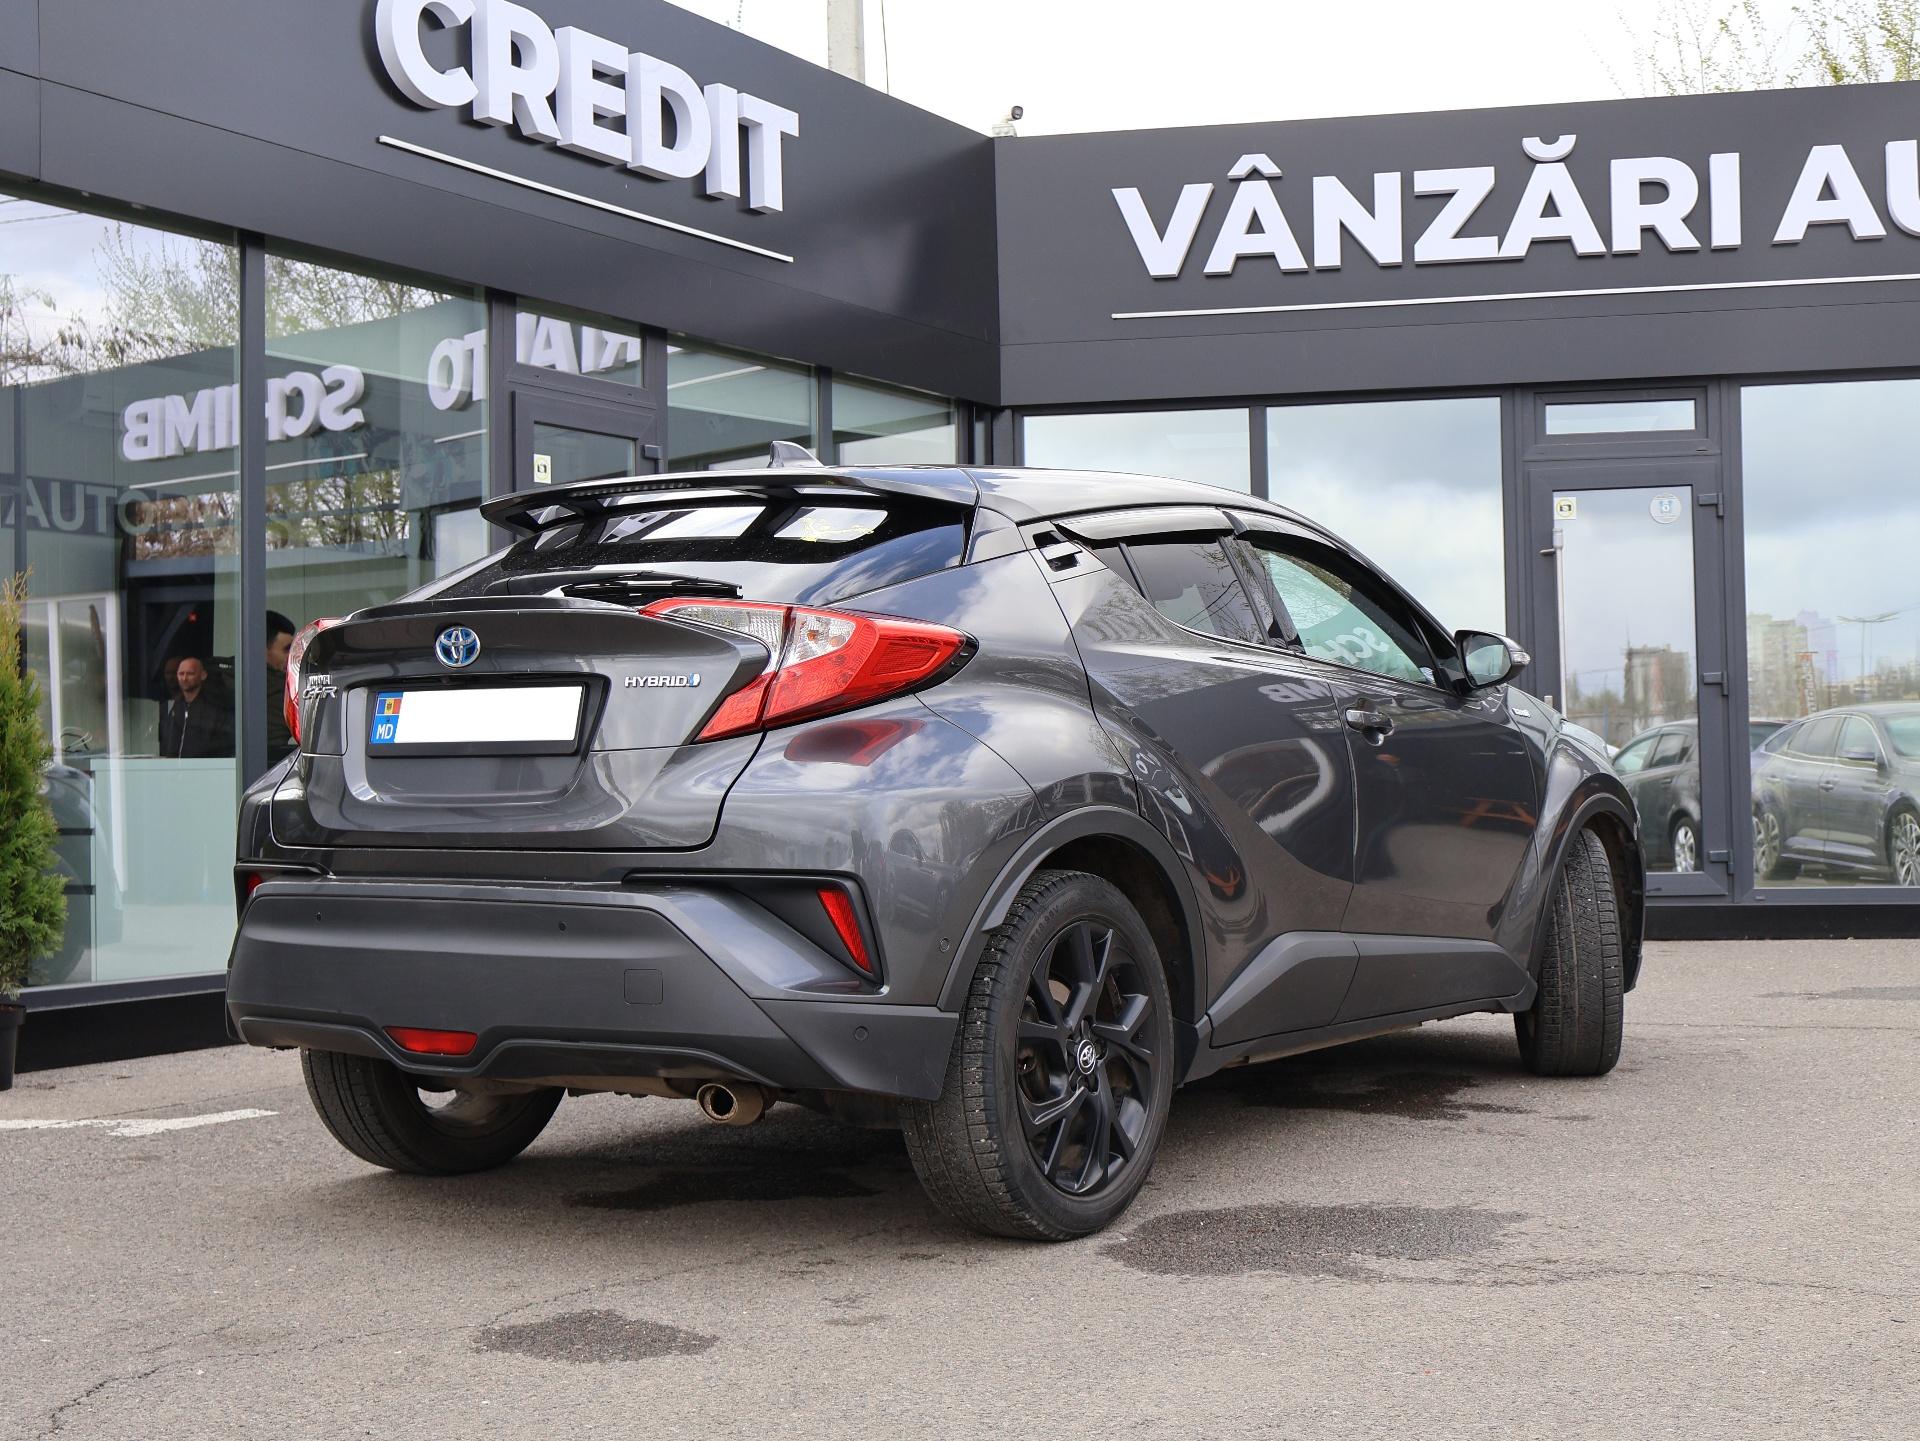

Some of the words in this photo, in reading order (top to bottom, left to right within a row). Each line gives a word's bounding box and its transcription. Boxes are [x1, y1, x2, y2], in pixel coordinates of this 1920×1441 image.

[375, 0, 799, 213] CREDIT
[1112, 134, 1741, 278] VÂNZĂRI
[624, 675, 688, 687] HYBRID
[375, 723, 394, 740] MD
